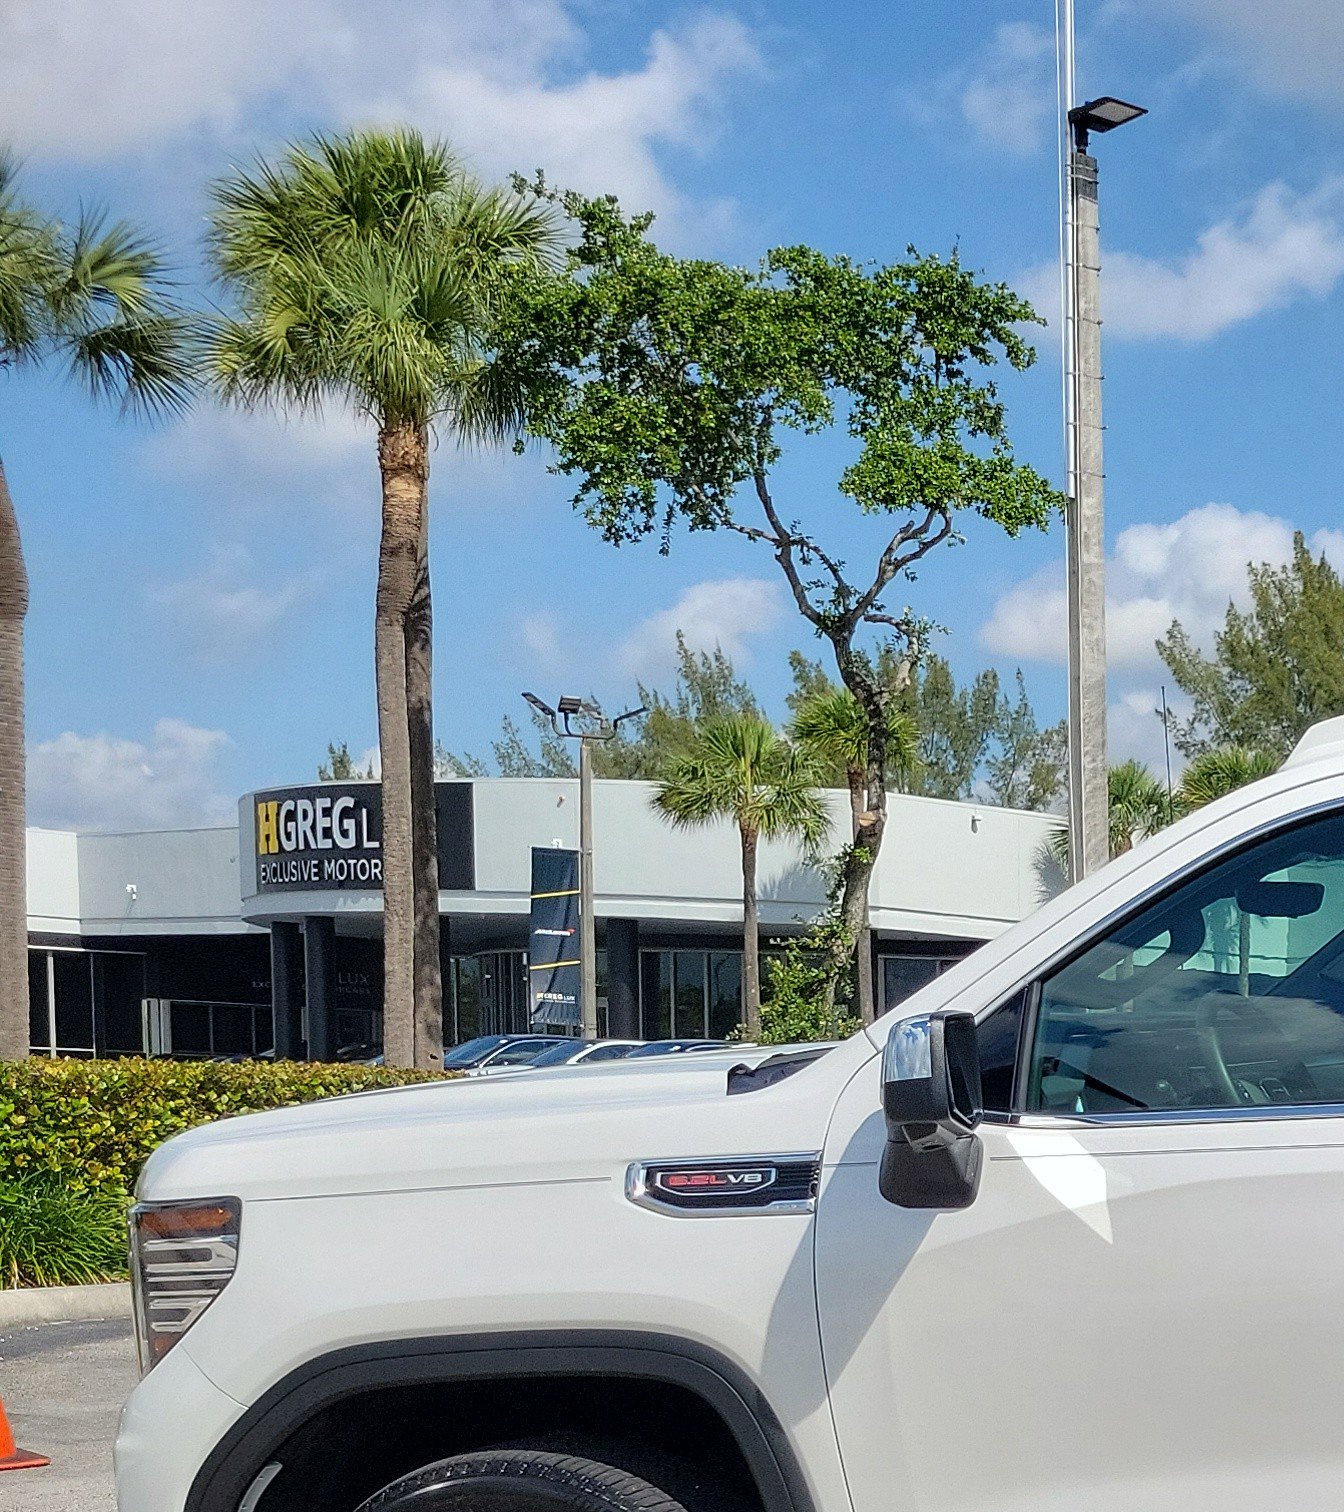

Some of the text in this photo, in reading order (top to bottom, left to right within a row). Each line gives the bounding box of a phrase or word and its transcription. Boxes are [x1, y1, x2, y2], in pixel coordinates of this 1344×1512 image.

[257, 796, 356, 855] HGREG
[261, 858, 382, 884] EXCLUSIVE MOTOR
